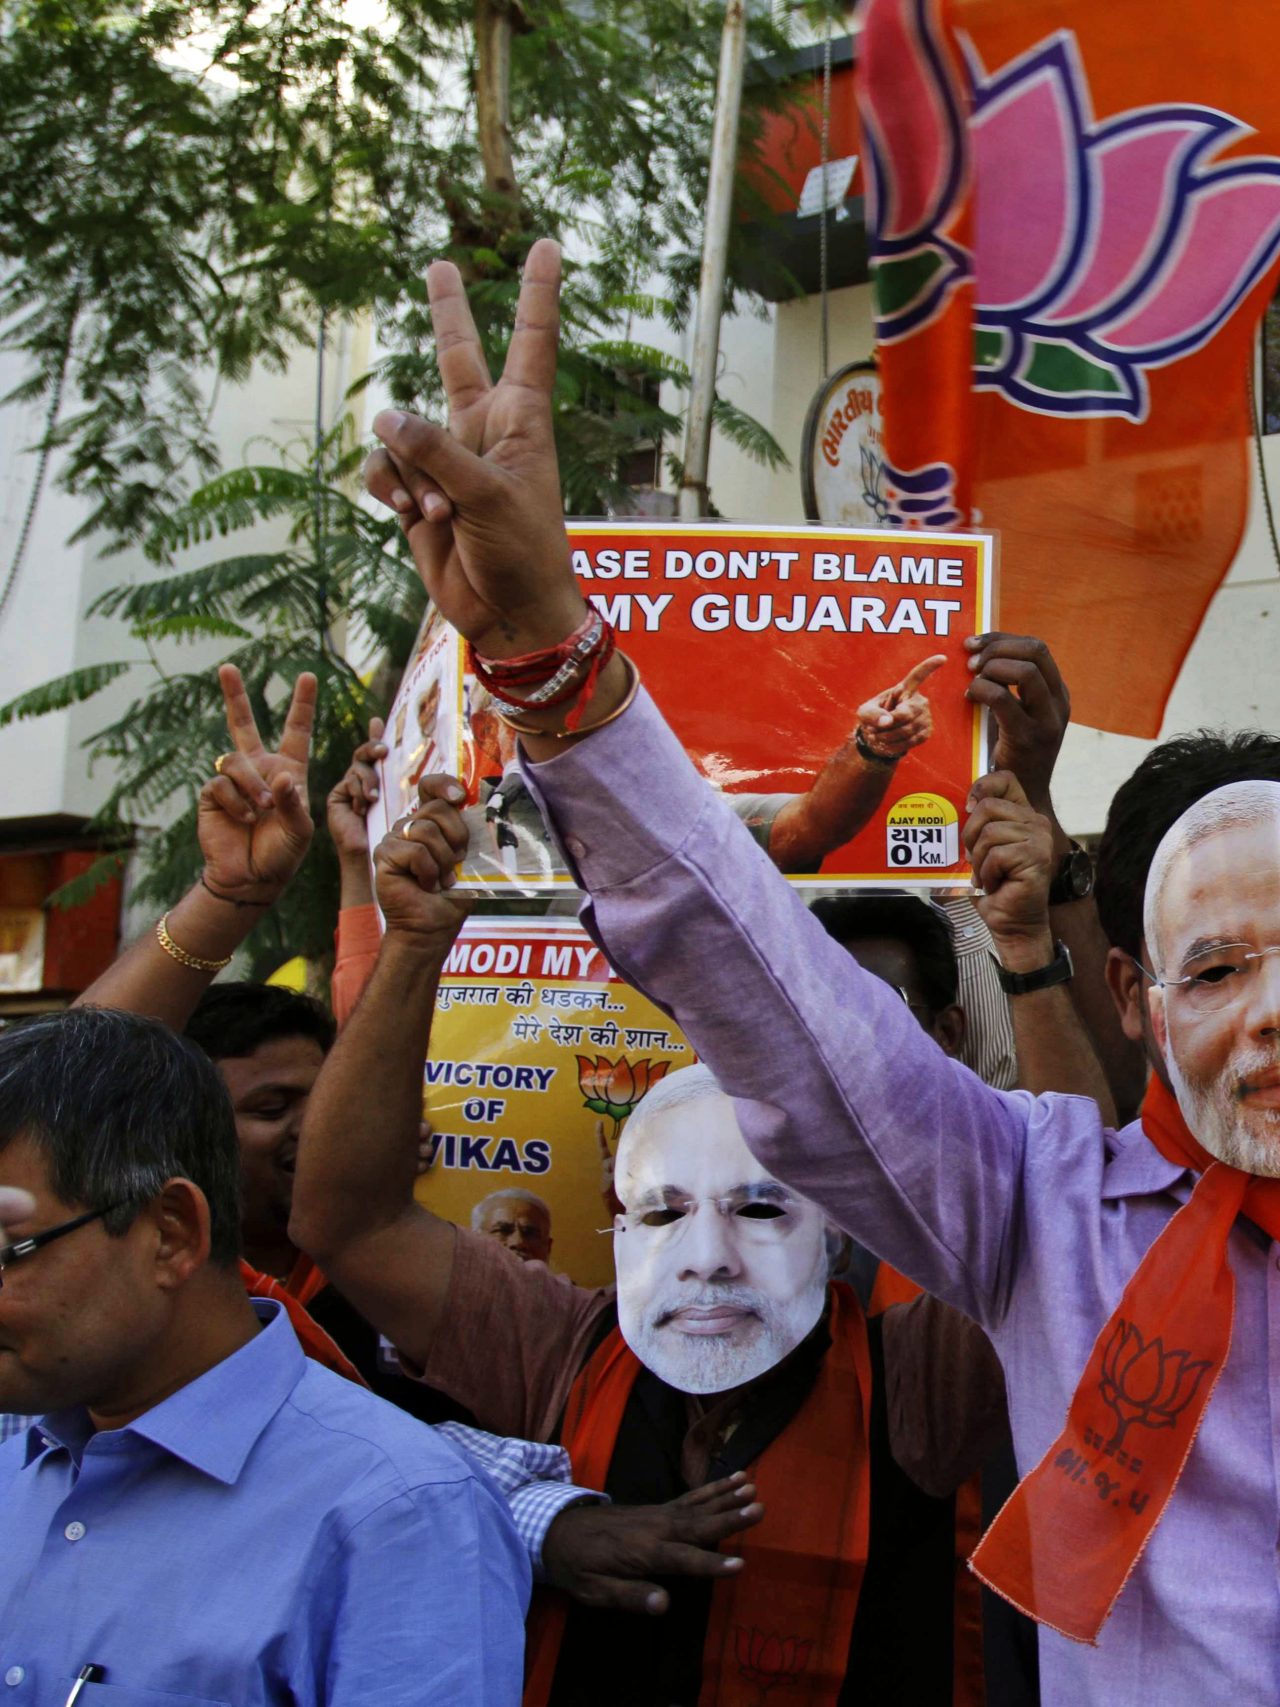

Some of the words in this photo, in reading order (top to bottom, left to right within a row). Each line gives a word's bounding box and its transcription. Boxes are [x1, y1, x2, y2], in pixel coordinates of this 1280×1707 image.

[665, 550, 799, 580] DON'T
[812, 553, 964, 587] BLAME
[589, 593, 674, 632] MY
[690, 594, 961, 637] GUJARAT
[889, 816, 915, 825] AJAY
[917, 816, 944, 825] MODI
[890, 844, 913, 866] 0
[440, 944, 532, 975] MODI
[541, 946, 600, 978] MY
[437, 986, 500, 1011] गुजरात
[505, 982, 535, 1006] की
[512, 1015, 543, 1042] मेरे
[550, 1020, 581, 1047] देश
[590, 1022, 618, 1048] की
[425, 1061, 555, 1091] VICTORY
[463, 1098, 504, 1123] OF
